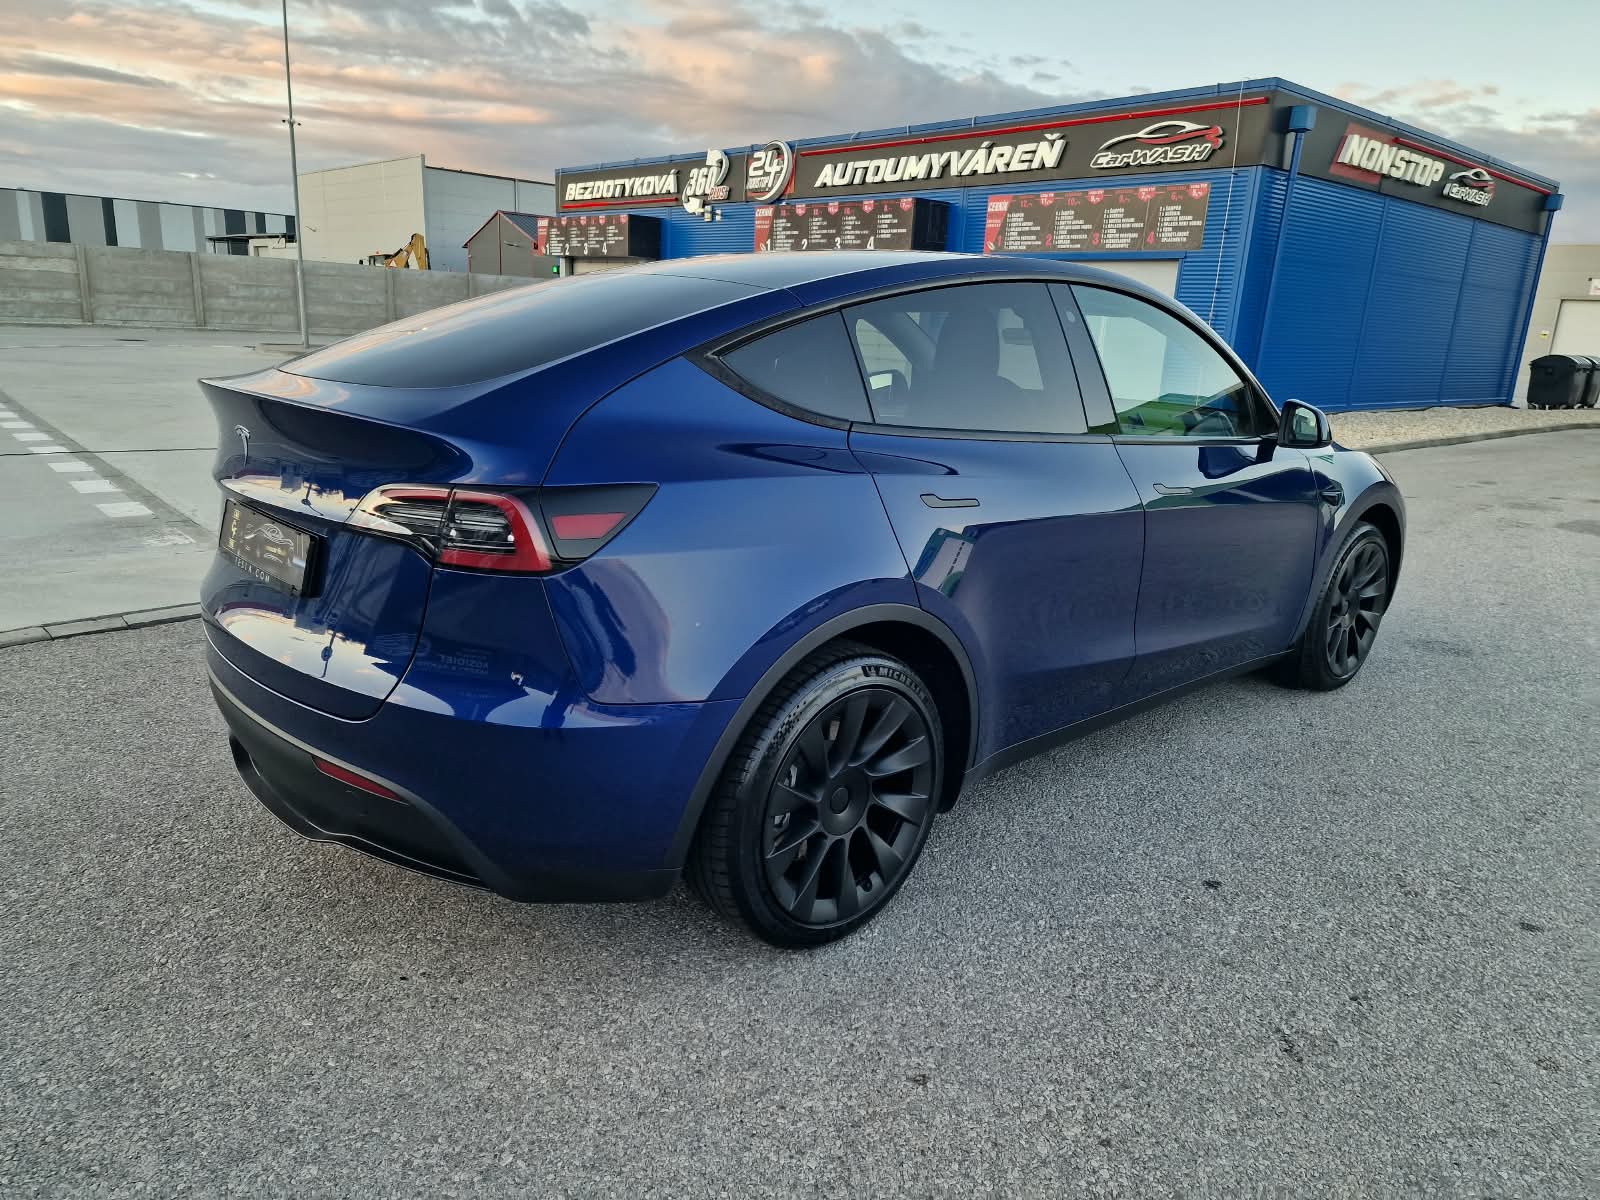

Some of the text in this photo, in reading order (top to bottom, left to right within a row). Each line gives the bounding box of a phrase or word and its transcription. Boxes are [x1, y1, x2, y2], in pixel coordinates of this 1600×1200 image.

[749, 151, 784, 188] 24
[814, 133, 1067, 188] AUTOUMYVÁREŇ
[1338, 134, 1445, 187] NONSTOP
[565, 169, 680, 201] BEZDOTYKOVÁ
[686, 167, 721, 196] 360
